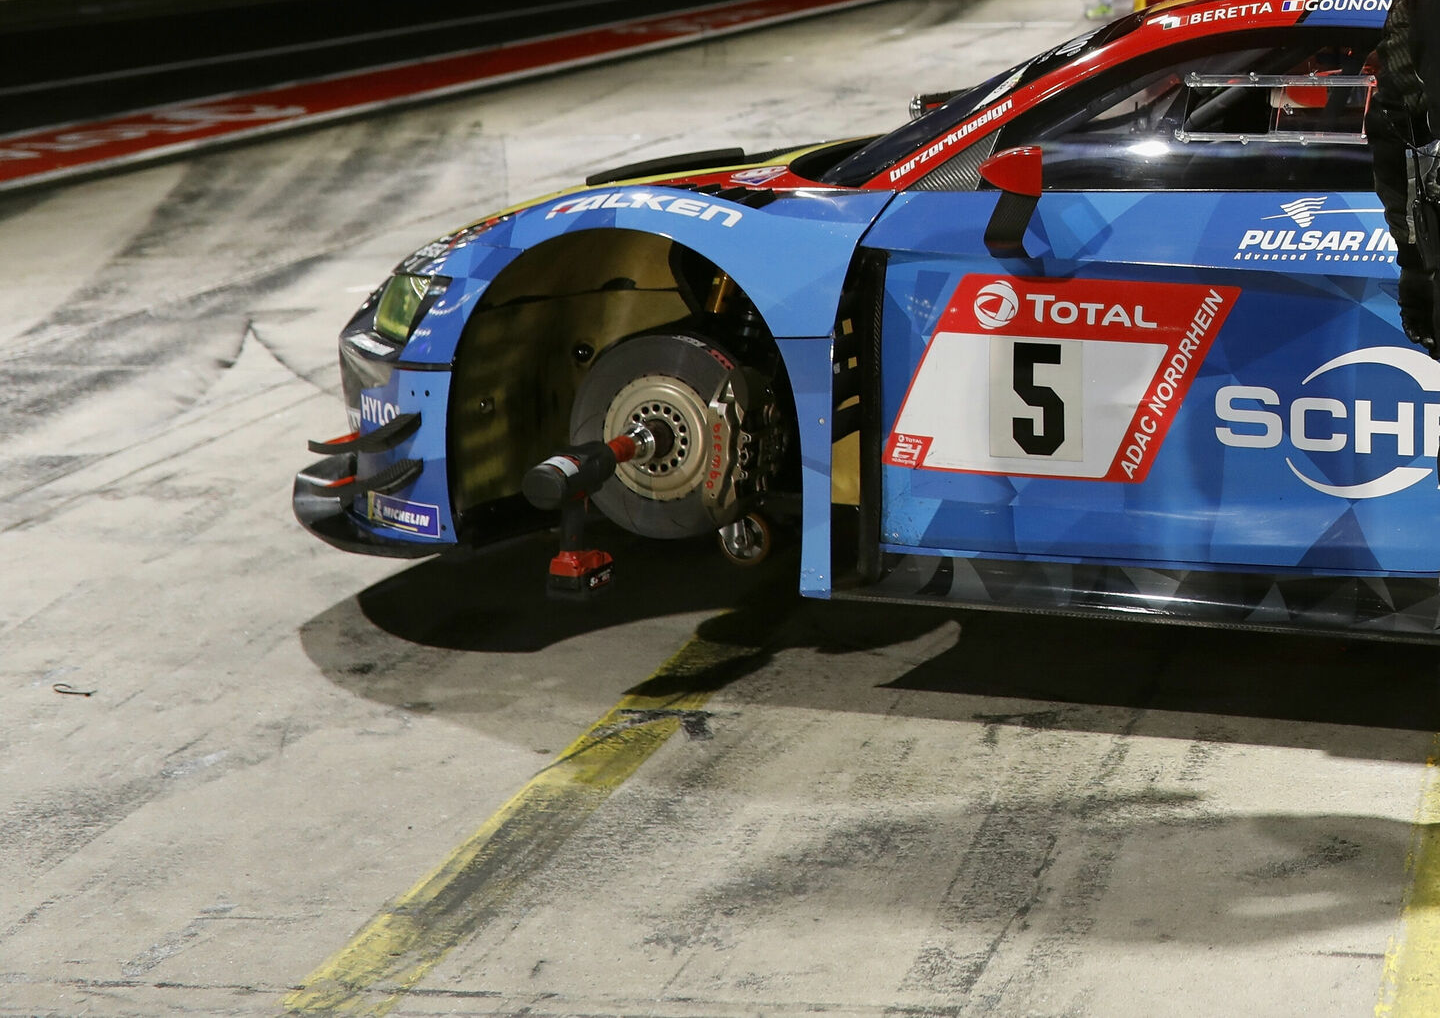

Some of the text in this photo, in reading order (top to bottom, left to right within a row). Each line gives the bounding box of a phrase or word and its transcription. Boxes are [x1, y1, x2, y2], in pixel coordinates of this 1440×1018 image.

[1190, 1, 1273, 25] BERETTA
[545, 192, 743, 228] FALKEN
[1234, 252, 1307, 261] Advanced
[1238, 230, 1365, 251] PULSAR
[1026, 293, 1158, 329] TOTAL
[1012, 341, 1066, 457] 5
[1119, 288, 1226, 481] ADAC NORDRHEIN
[705, 422, 722, 490] brembo
[382, 505, 431, 528] MICHELIN
